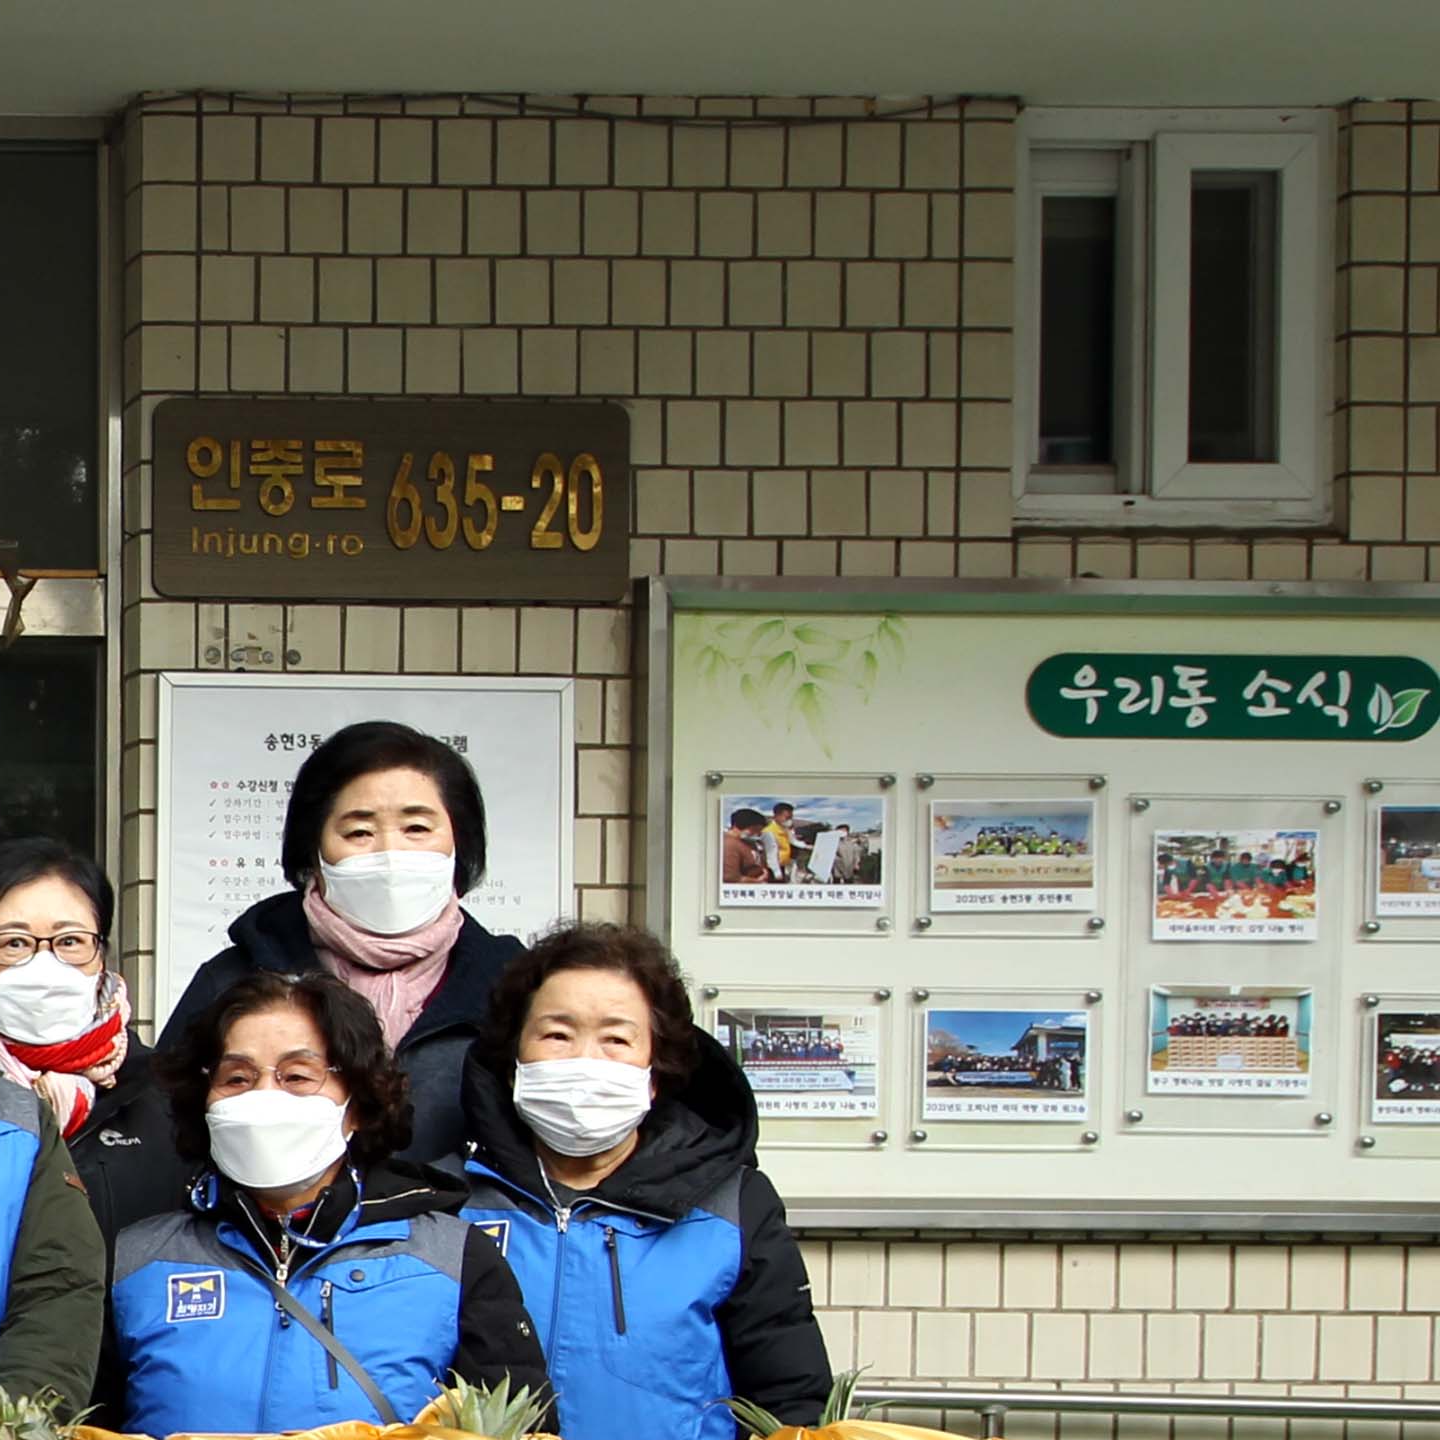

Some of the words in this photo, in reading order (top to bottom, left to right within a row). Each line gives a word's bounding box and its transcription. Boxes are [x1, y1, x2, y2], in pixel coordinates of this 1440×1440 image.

[185, 436, 369, 516] 인중로
[385, 452, 605, 552] 635-20
[1060, 665, 1217, 728] 우리동
[1242, 665, 1352, 728] 소식
[235, 780, 276, 794] 수강신청
